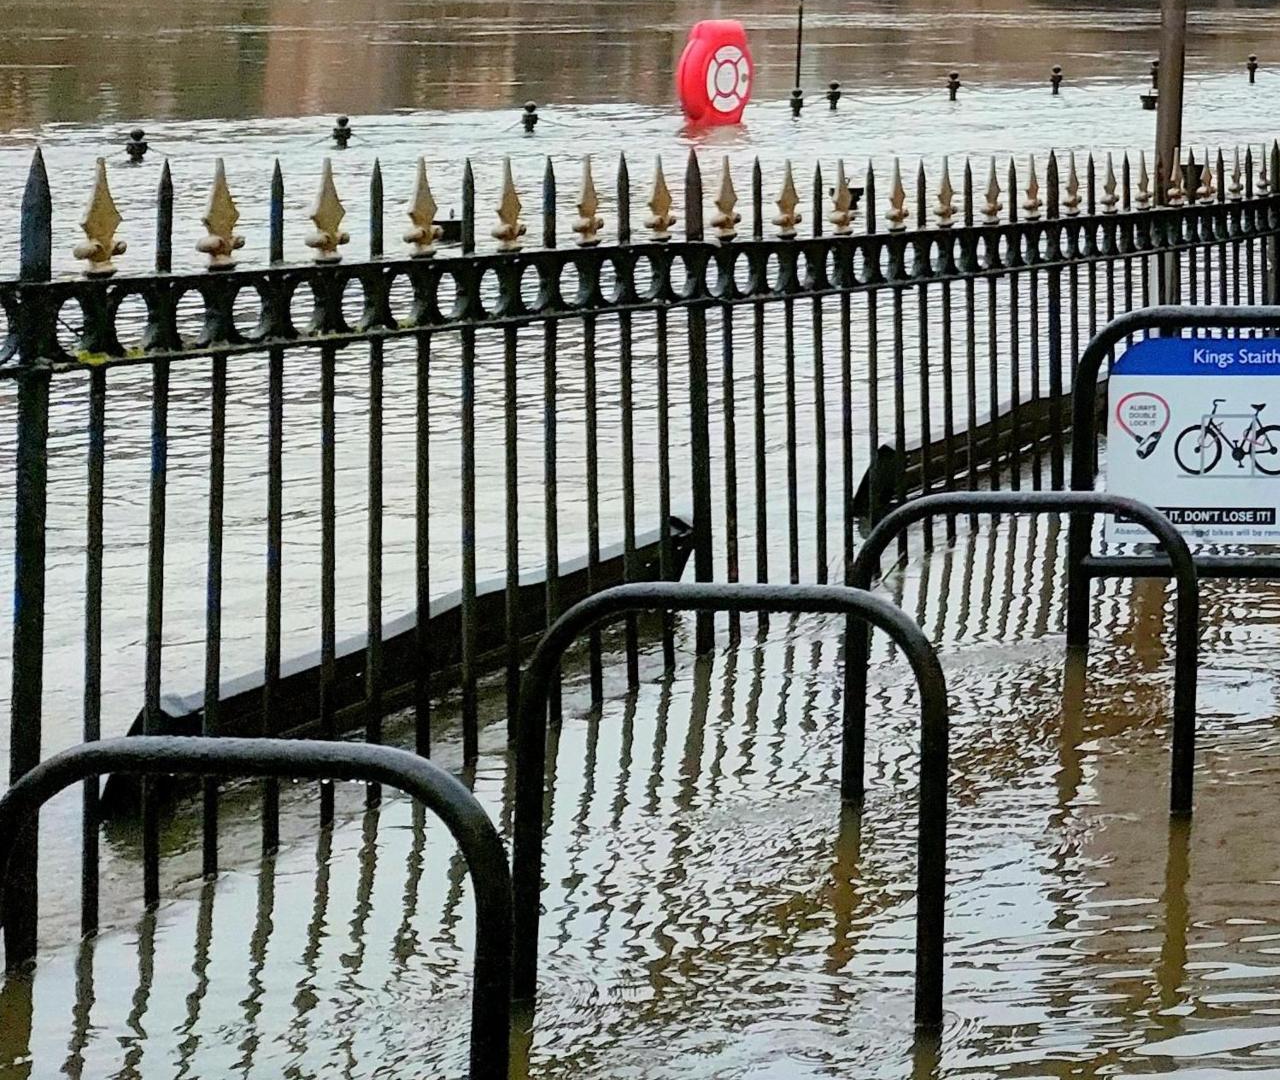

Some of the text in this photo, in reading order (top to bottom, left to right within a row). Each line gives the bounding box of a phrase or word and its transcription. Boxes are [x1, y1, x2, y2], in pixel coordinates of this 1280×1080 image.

[1193, 348, 1234, 368] Kings
[1169, 510, 1181, 523] IT,
[1184, 510, 1221, 522] DON'T
[1222, 511, 1254, 522] LOSE
[1256, 510, 1271, 522] IT!
[1211, 528, 1234, 536] bikes
[1236, 528, 1250, 536] will
[1252, 528, 1262, 536] be
